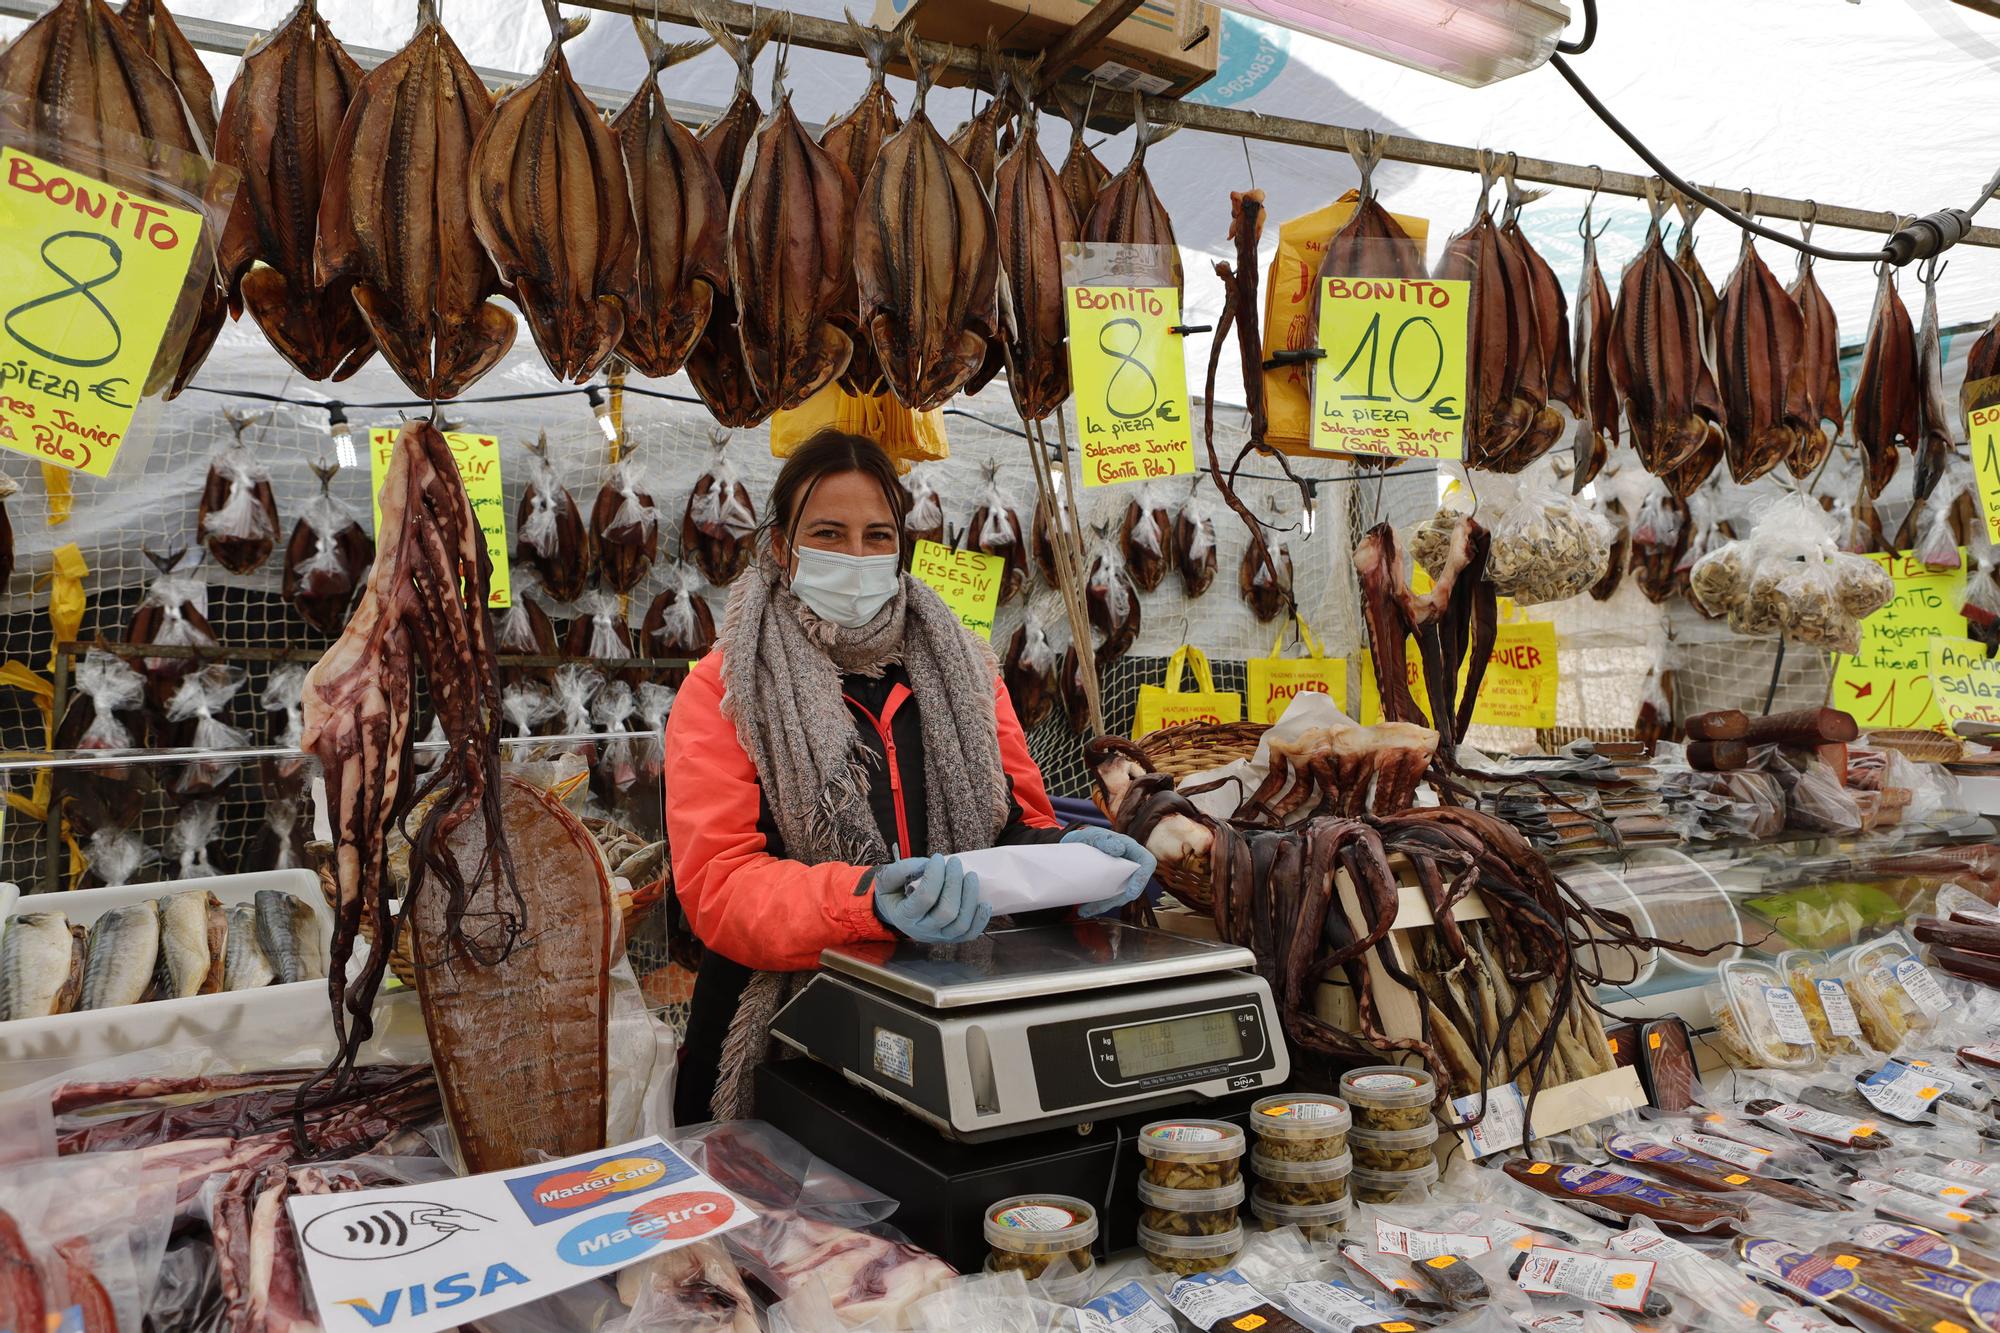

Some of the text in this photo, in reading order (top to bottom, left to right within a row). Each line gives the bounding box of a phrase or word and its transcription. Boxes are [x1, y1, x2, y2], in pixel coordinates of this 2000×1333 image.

[4, 231, 123, 368] 8
[1099, 318, 1157, 419] 8
[1332, 312, 1444, 403] 10
[88, 377, 133, 409] €
[1428, 396, 1462, 420] €
[1155, 399, 1181, 422] €
[50, 409, 120, 448] Javier
[1321, 421, 1455, 443] Salazones Javier
[1085, 439, 1188, 458] Salazones Javier
[923, 542, 987, 571] LOTES
[1102, 1037, 1112, 1046] kg
[1105, 1053, 1115, 1063] kg
[1233, 1078, 1256, 1087] DINA
[539, 1161, 662, 1204] MasterCard
[577, 1200, 718, 1257] Maestro
[332, 1261, 532, 1328] VISA
